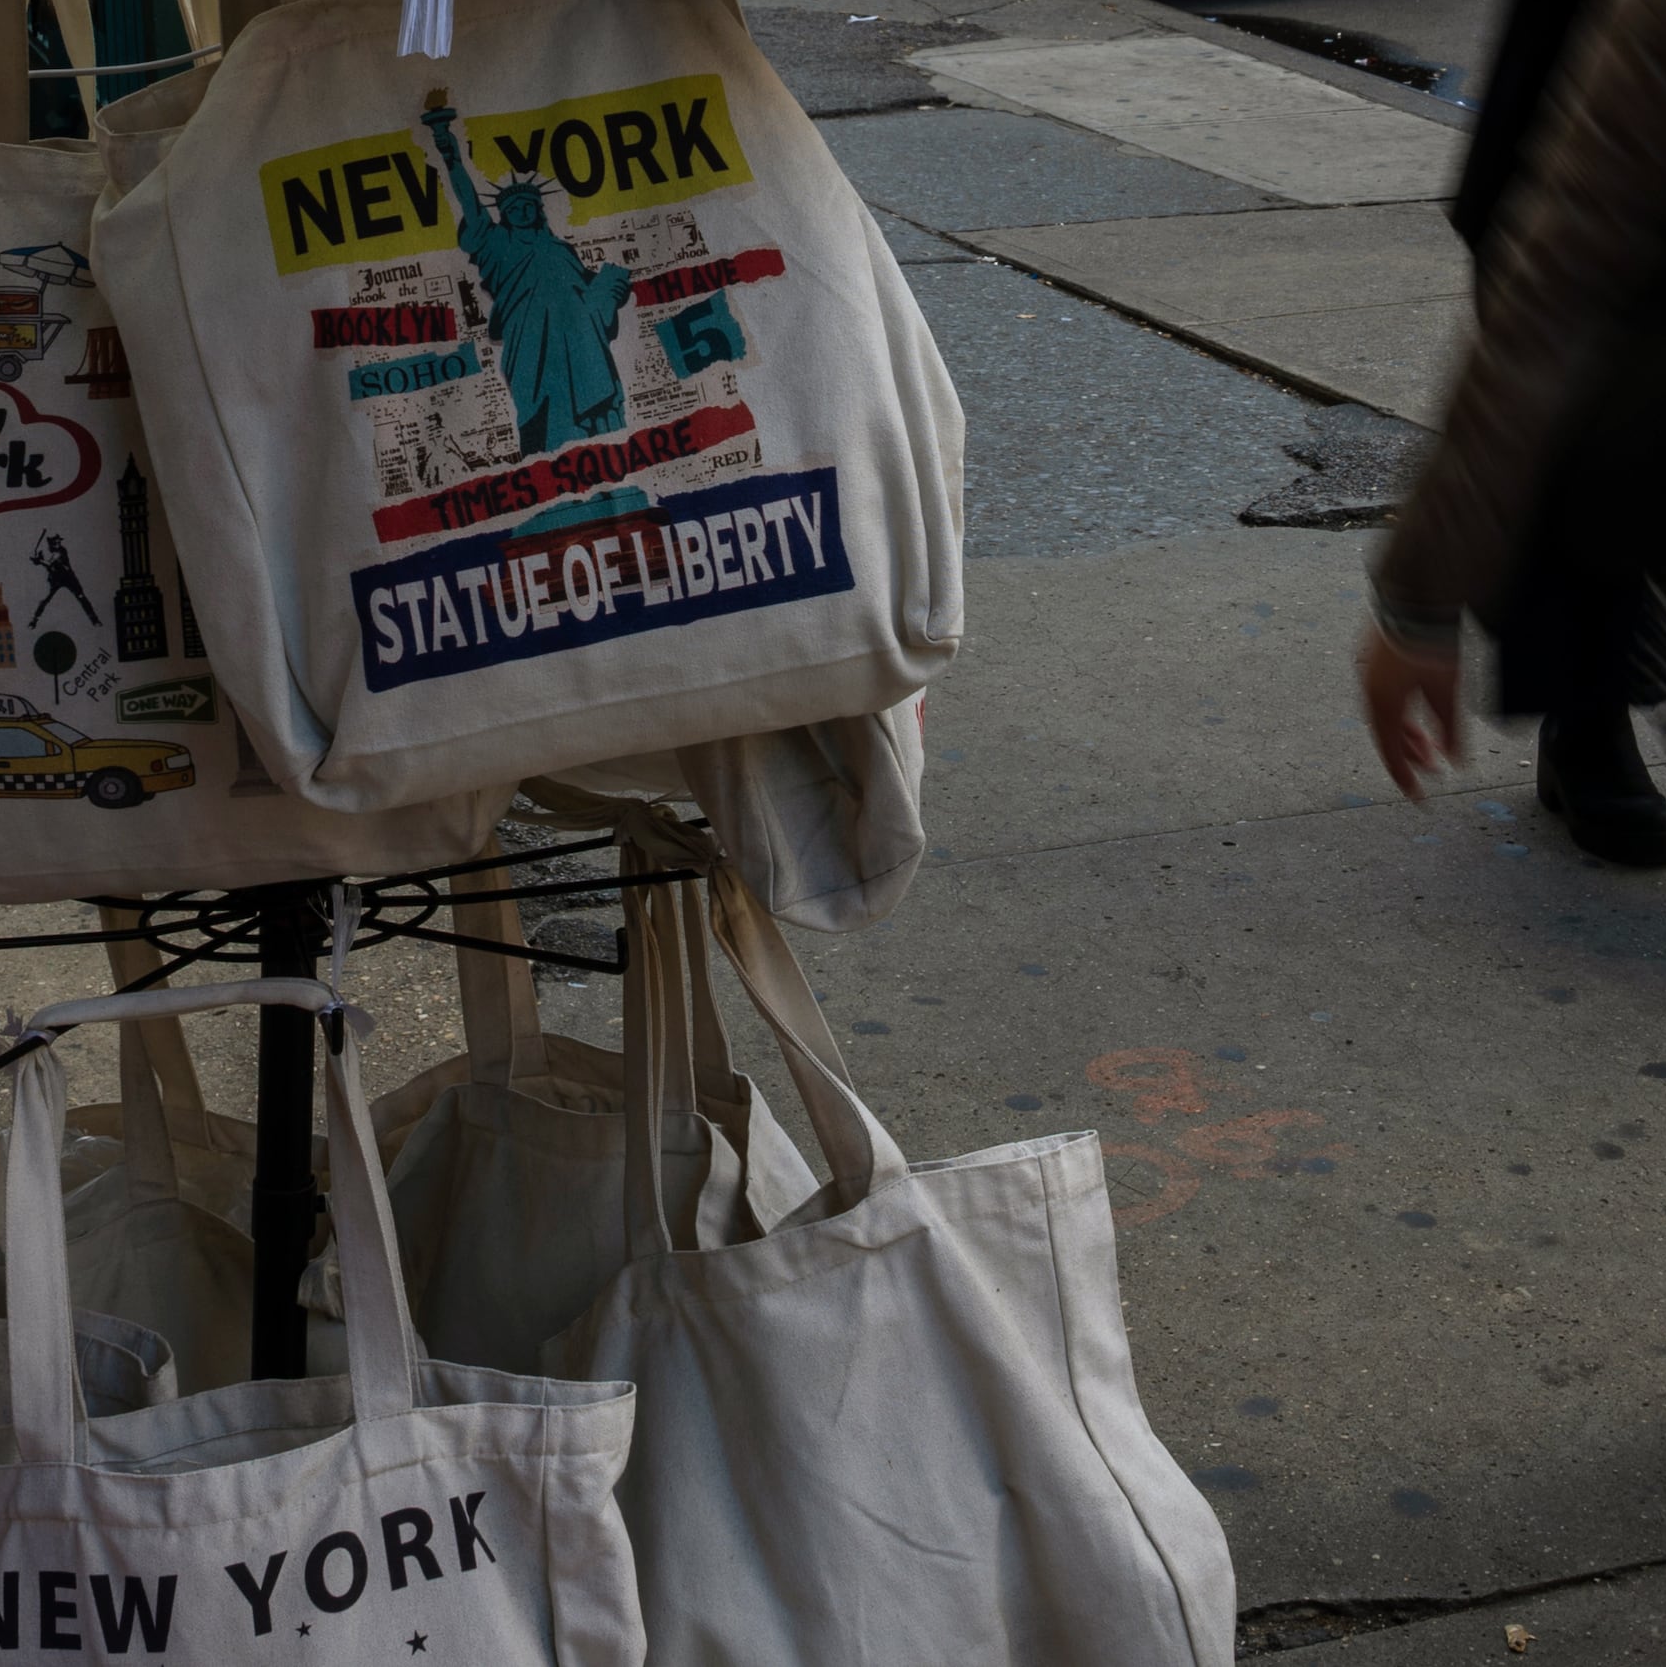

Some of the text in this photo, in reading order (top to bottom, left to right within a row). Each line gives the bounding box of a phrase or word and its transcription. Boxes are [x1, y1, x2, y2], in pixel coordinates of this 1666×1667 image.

[493, 97, 730, 200] YORK
[359, 261, 423, 292] Journal
[398, 282, 418, 297] the
[691, 258, 741, 294] AVE
[671, 300, 733, 375] 5
[359, 354, 468, 399] SOHO
[430, 419, 700, 531] TIMES SQUARE
[711, 448, 749, 469] RED
[368, 492, 829, 666] STATUE OF LIBERTY
[62, 648, 113, 696] Central
[86, 672, 122, 703] Park
[126, 691, 200, 713] ONE WAY
[224, 1490, 498, 1638] YORK
